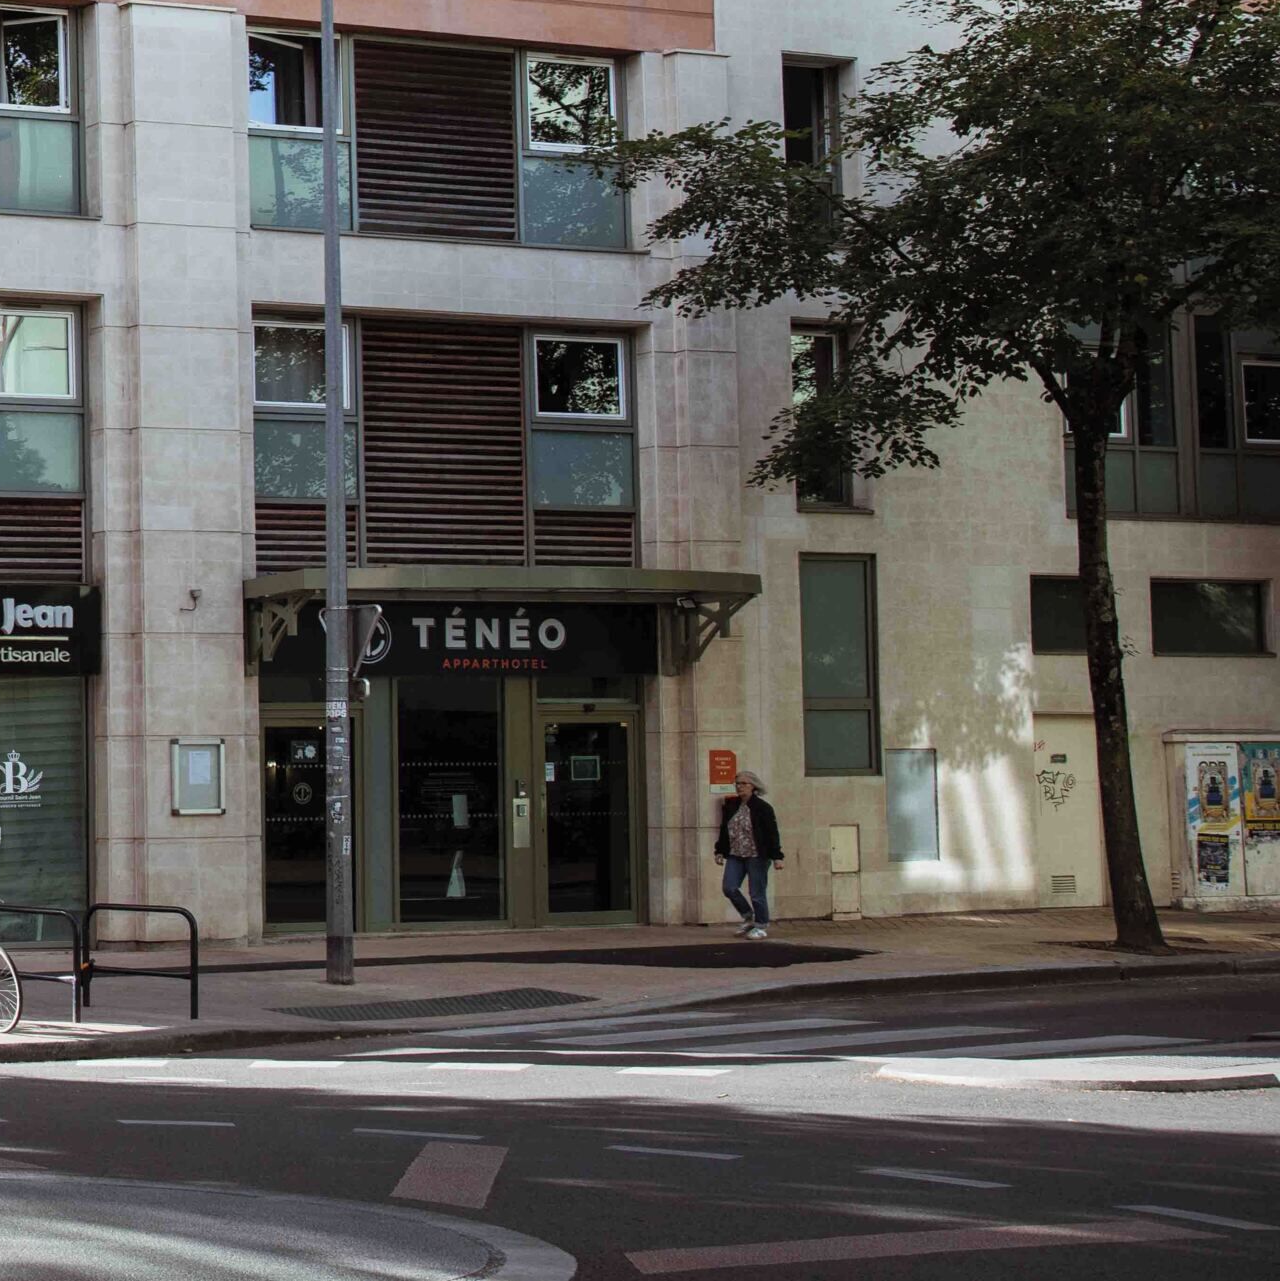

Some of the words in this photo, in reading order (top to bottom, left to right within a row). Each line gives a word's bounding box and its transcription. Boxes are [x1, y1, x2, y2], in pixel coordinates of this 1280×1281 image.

[0, 597, 74, 635] Jean
[412, 606, 566, 650] TÉNÉO
[443, 658, 548, 670] APPARTHOTEL
